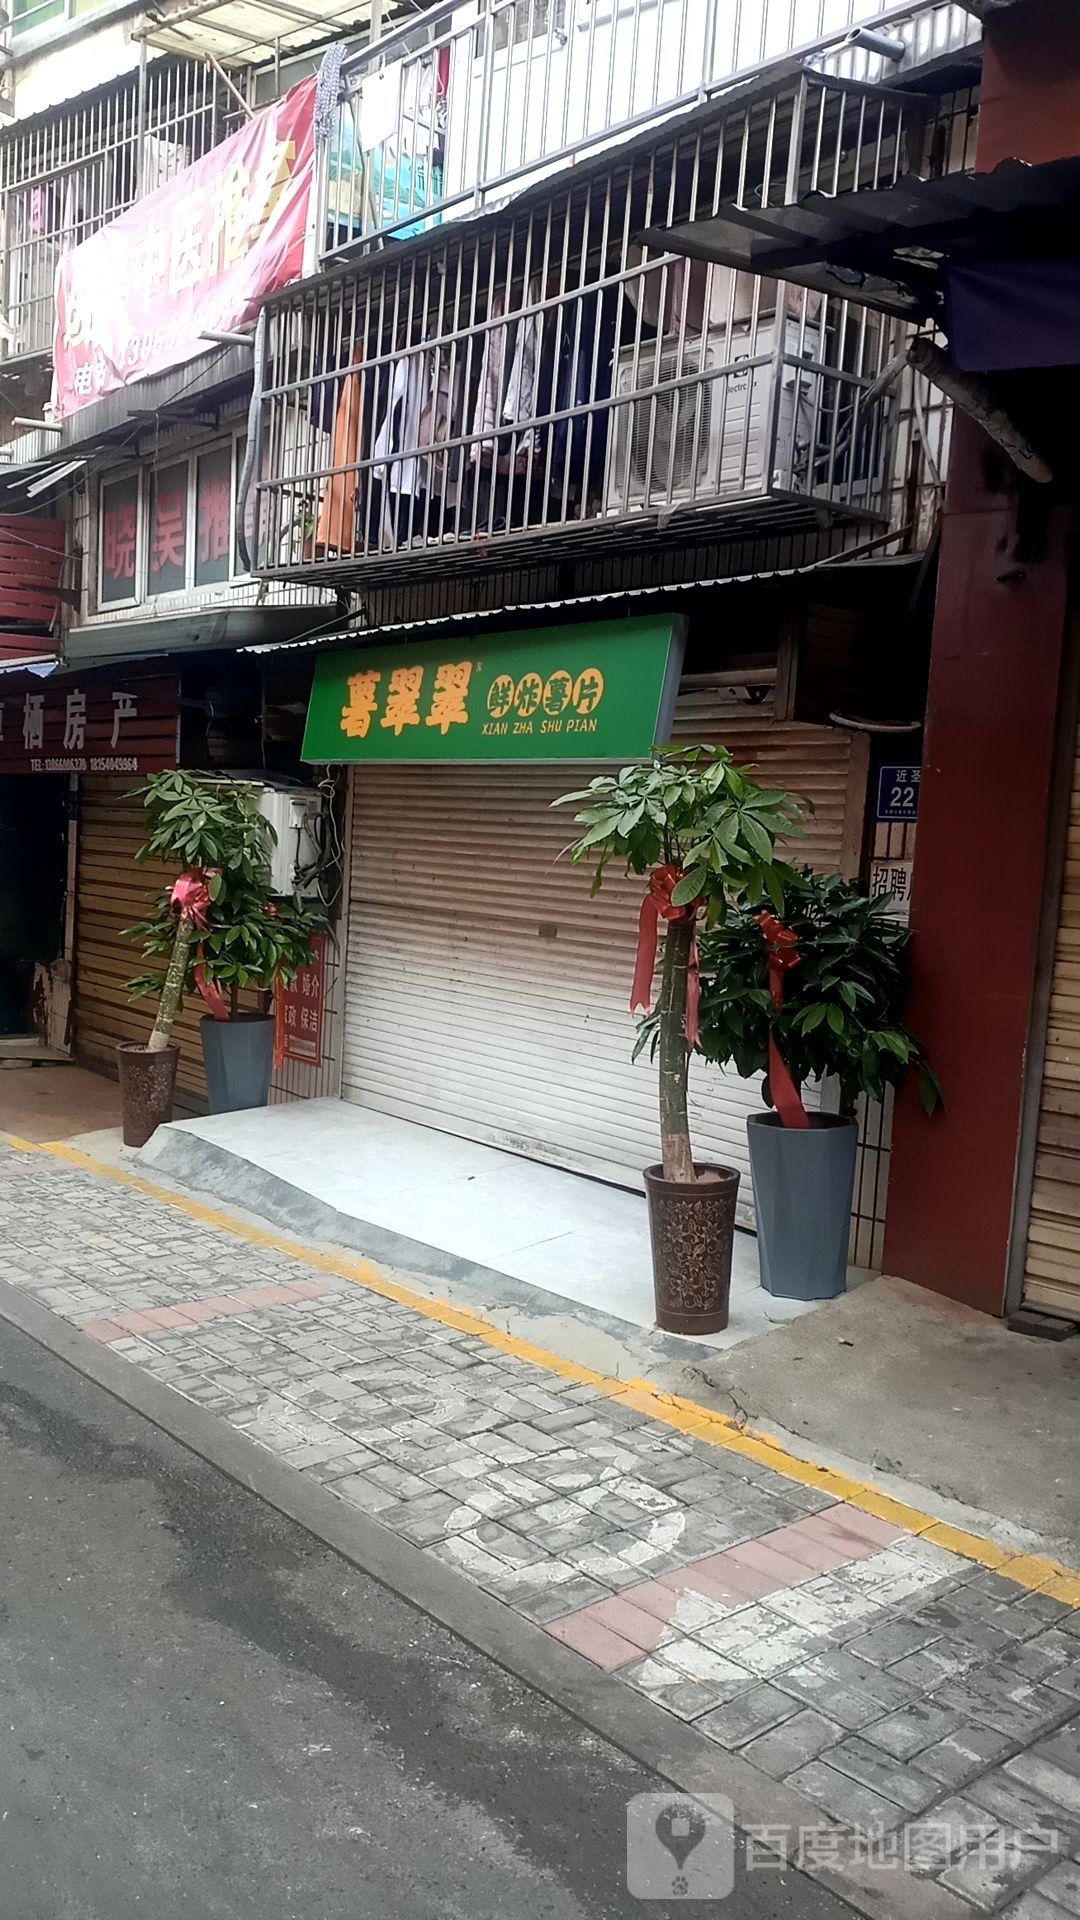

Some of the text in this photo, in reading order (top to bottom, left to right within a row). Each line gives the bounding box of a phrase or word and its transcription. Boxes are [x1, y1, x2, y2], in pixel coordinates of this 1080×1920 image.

[340, 660, 474, 739] 薯翠翠
[487, 667, 604, 719] 鲜炸薯片
[0, 688, 139, 750] 栖房产
[482, 718, 598, 736] XIAN ZHA SHU PIAN
[890, 786, 915, 808] 22
[871, 866, 912, 902] 招聘
[301, 1007, 319, 1032] 保洁
